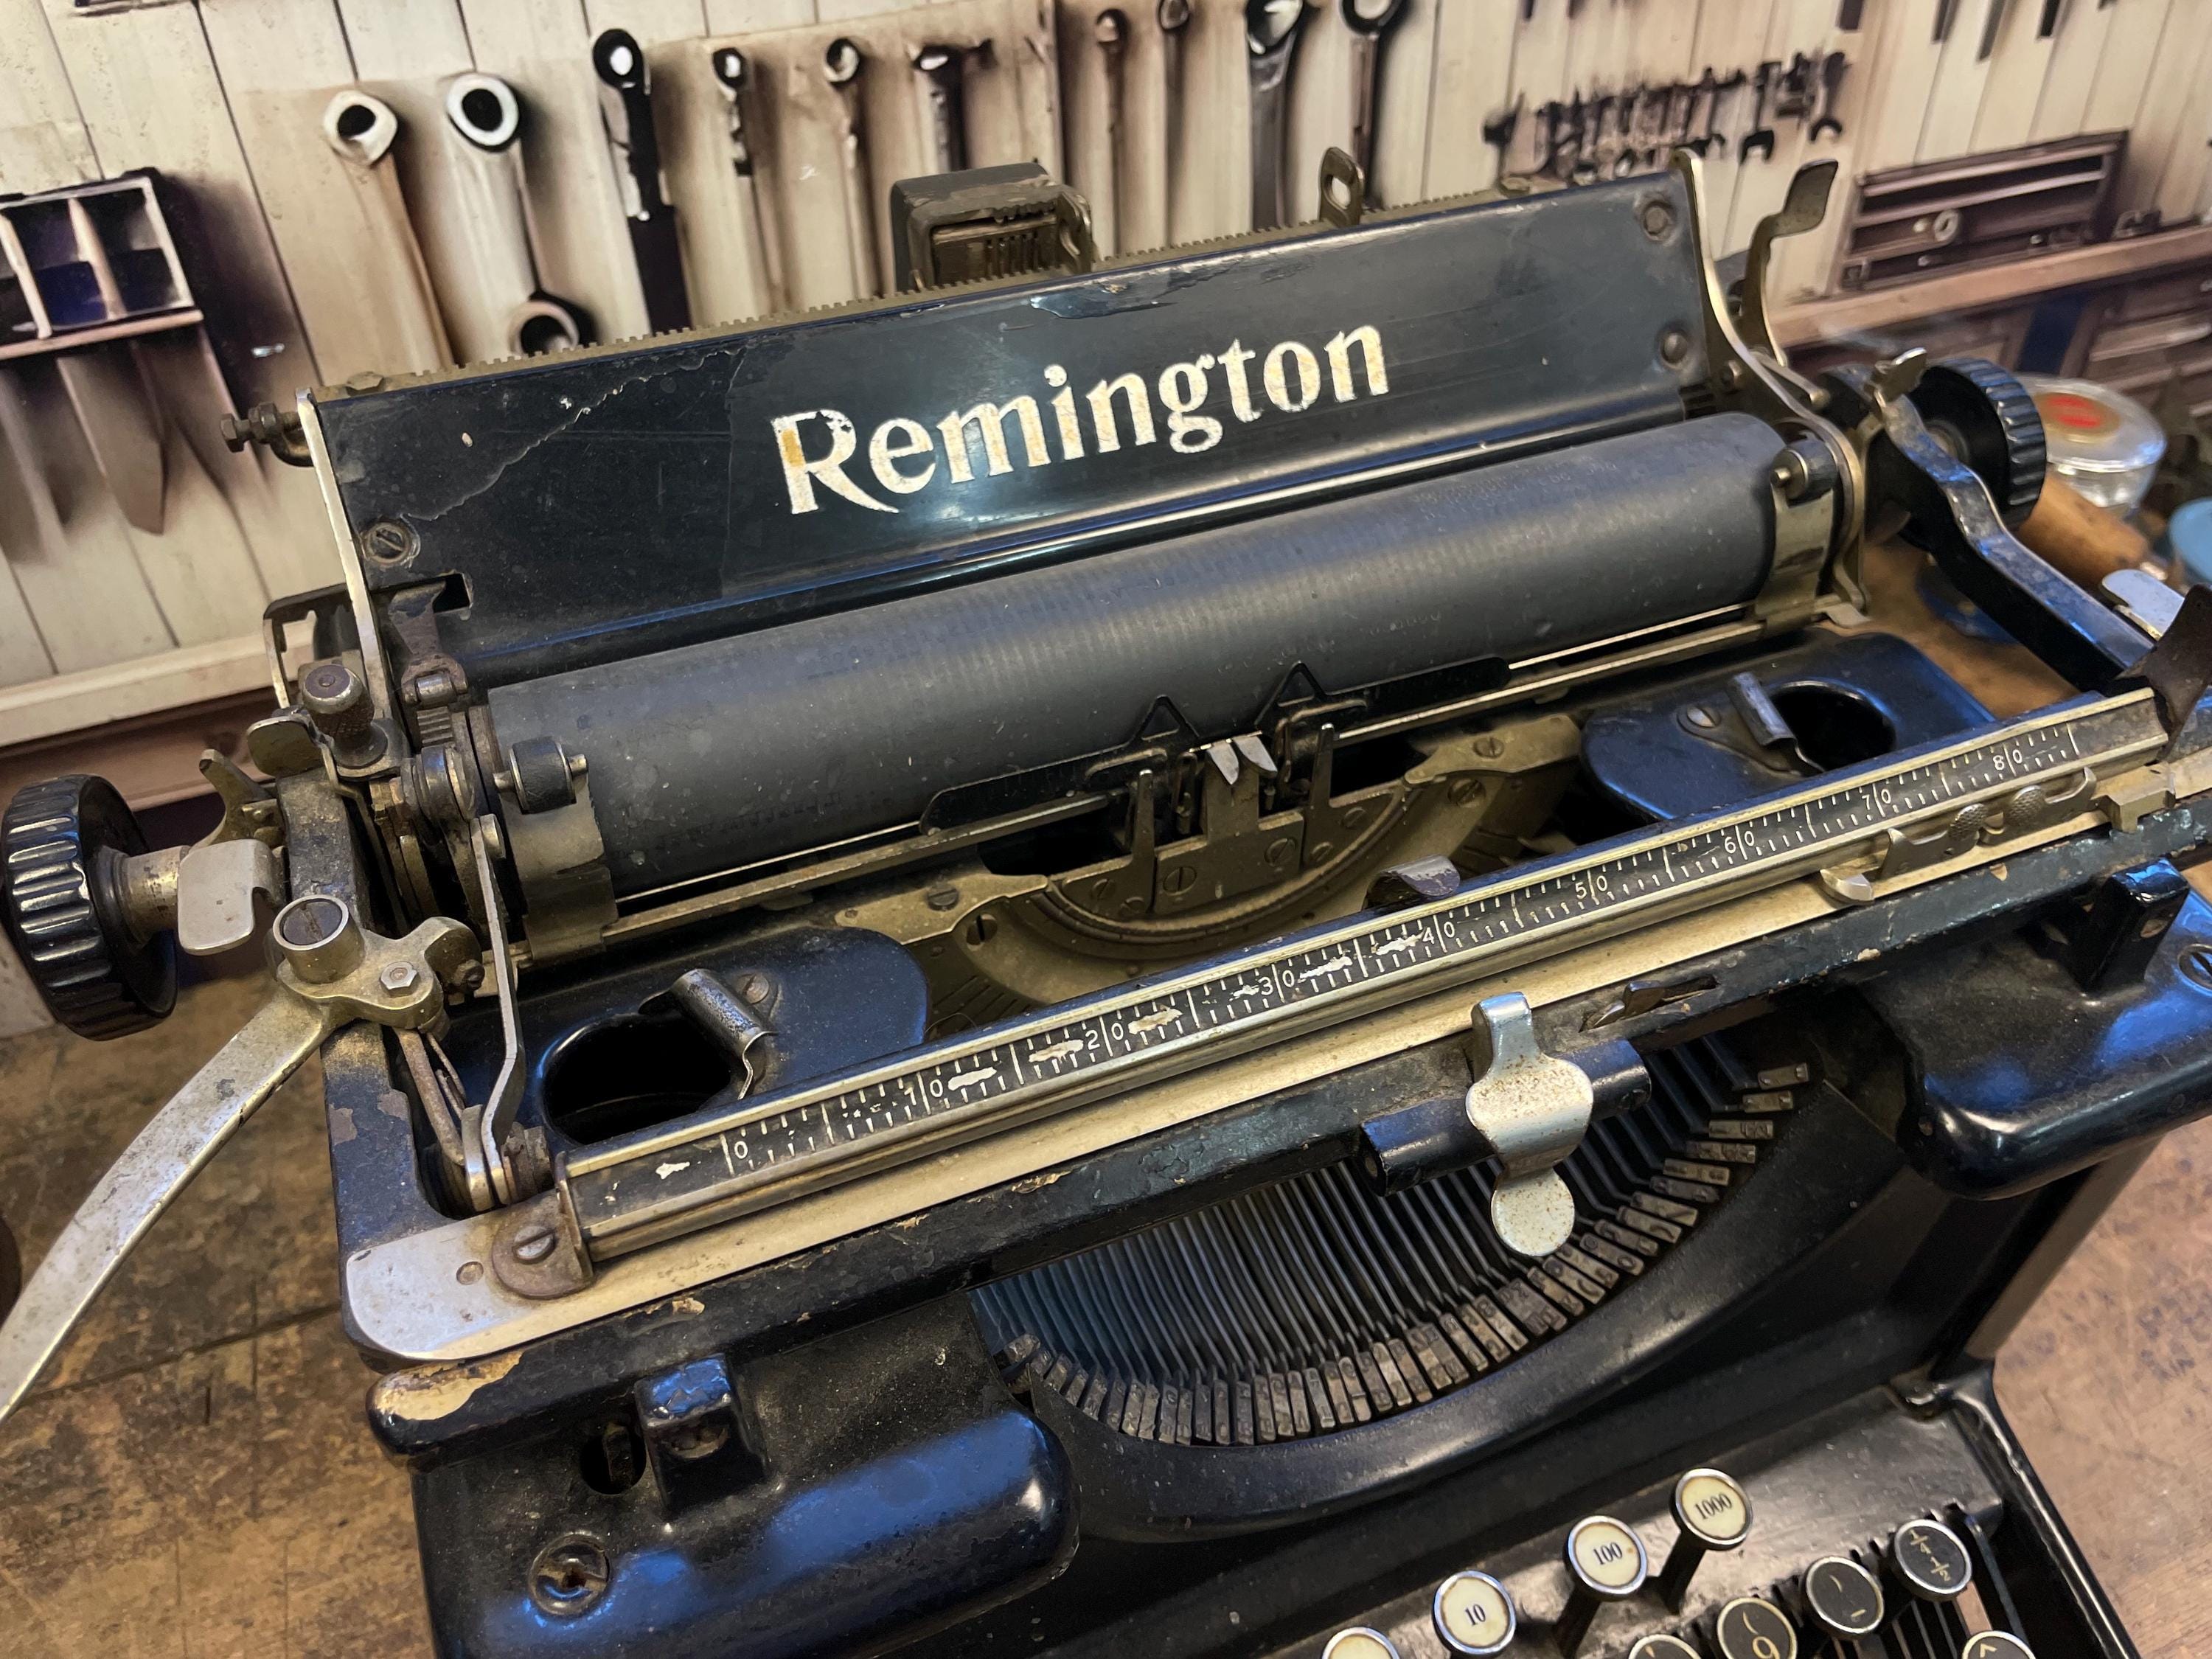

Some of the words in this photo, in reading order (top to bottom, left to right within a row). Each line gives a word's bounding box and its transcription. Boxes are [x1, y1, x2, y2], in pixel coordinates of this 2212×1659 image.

[771, 324, 1391, 515] Remington
[734, 1140, 748, 1160] 0
[1085, 1021, 1125, 1051] 20
[1259, 969, 1295, 996] 30
[1422, 921, 1456, 945] 40
[1575, 875, 1608, 900] 50
[1723, 829, 1756, 855] 60
[1861, 787, 1892, 811] 70
[1992, 748, 2023, 771] 80
[1694, 1492, 1733, 1520] 1000
[1593, 1541, 1623, 1565] 100
[1465, 1604, 1486, 1626] 10
